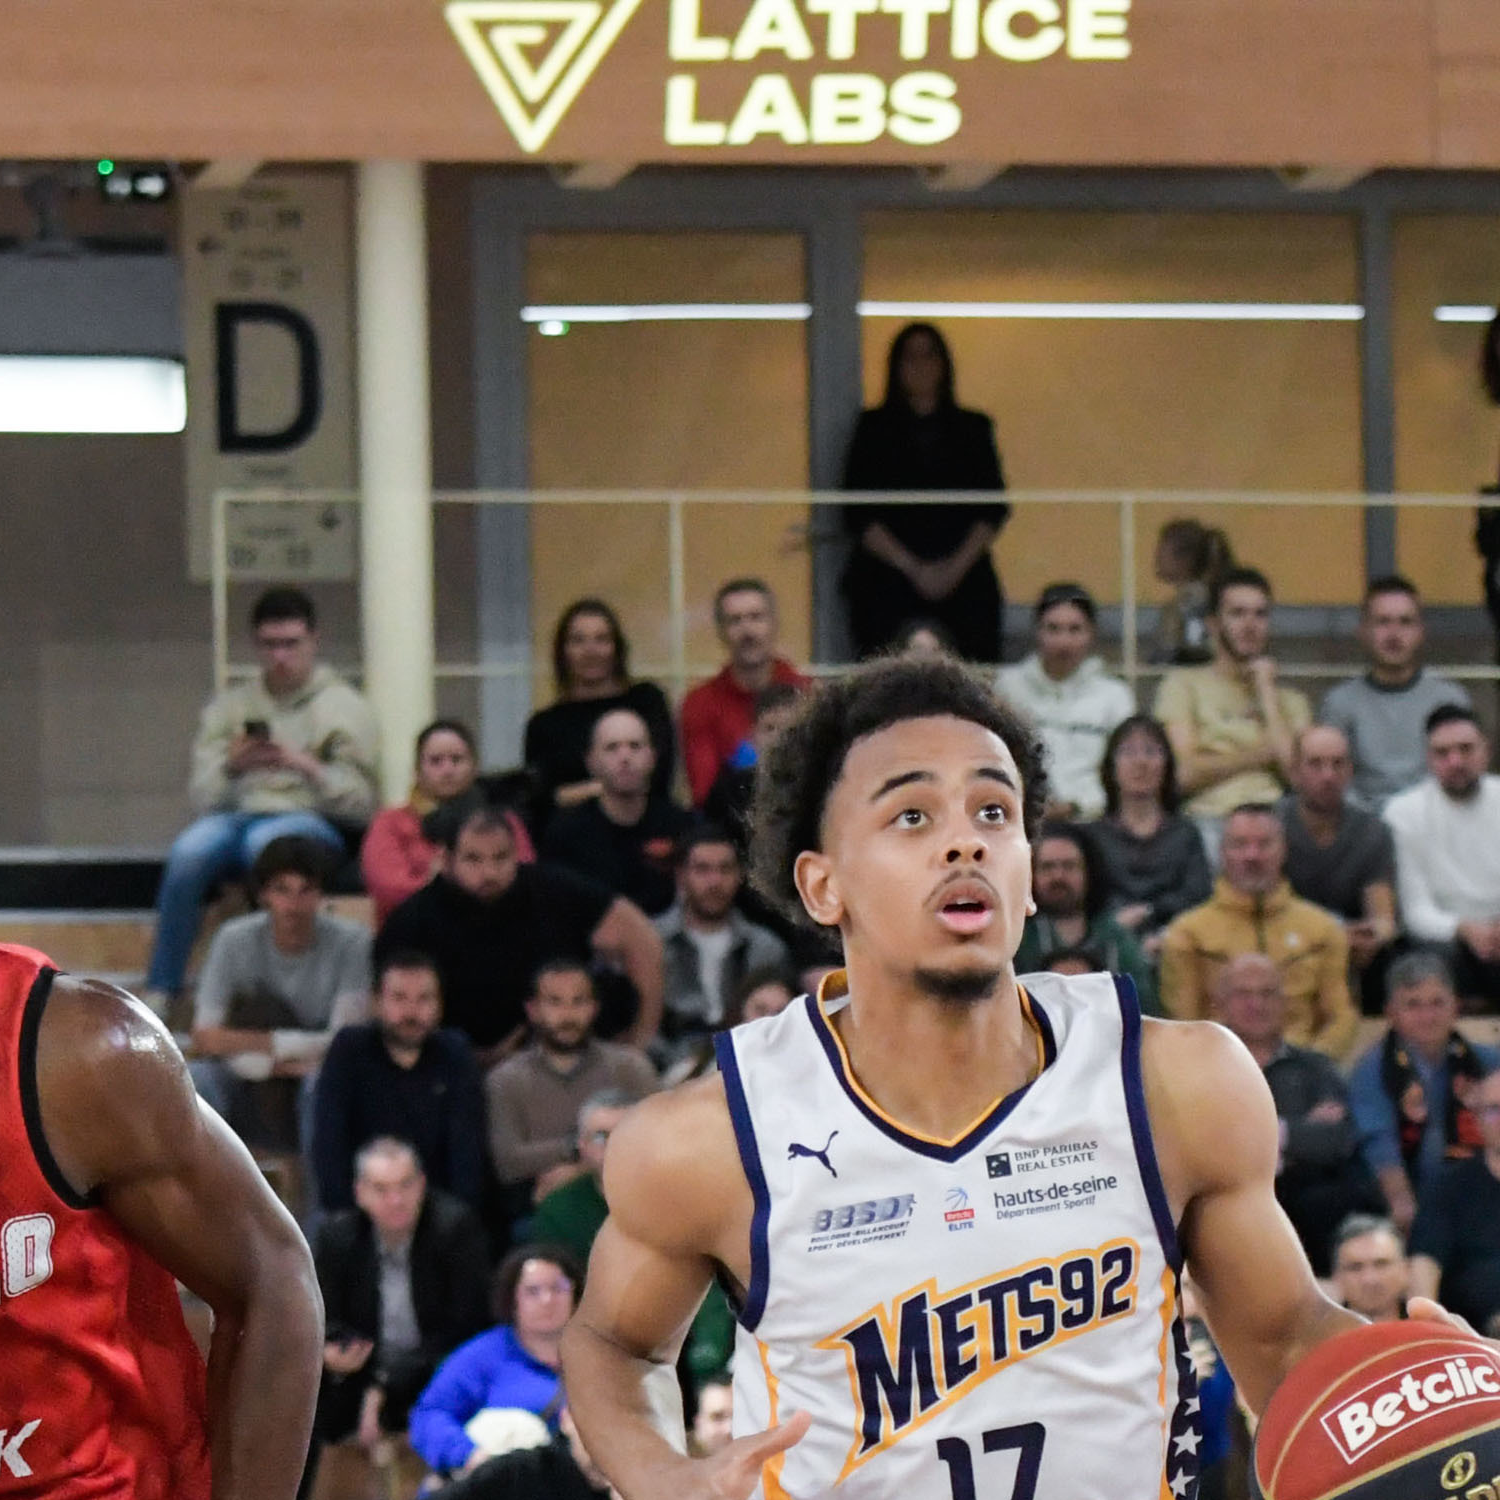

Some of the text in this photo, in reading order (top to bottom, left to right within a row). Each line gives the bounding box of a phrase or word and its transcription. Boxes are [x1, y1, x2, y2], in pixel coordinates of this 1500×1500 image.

[667, 0, 1135, 61] LATTICE
[663, 70, 964, 146] LABS
[215, 302, 324, 455] D
[1015, 1140, 1098, 1162] BNP PARIBAS
[1017, 1151, 1095, 1173] REAL ESTATE
[993, 1175, 1118, 1208] hauts-de-seine
[996, 1202, 1061, 1220] Département
[840, 1244, 1135, 1458] METS92
[1337, 1358, 1500, 1452] Betclic
